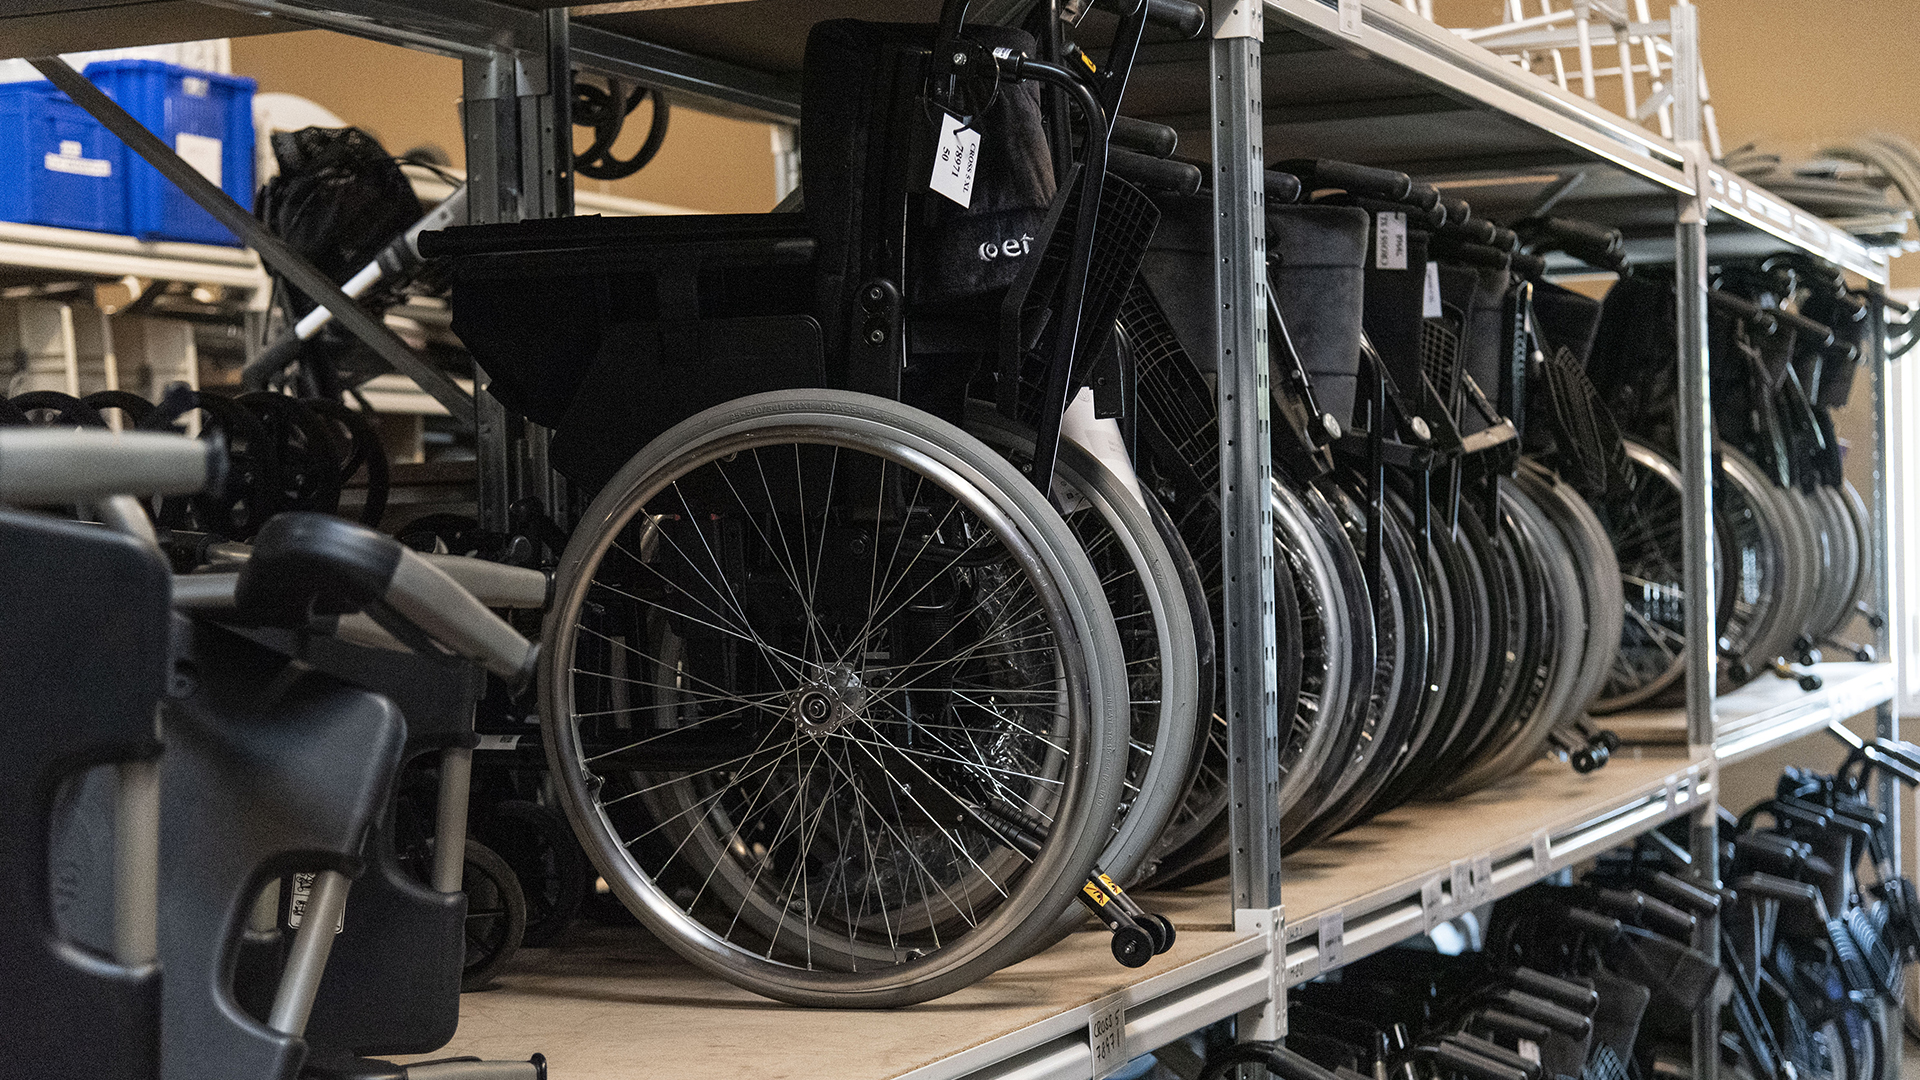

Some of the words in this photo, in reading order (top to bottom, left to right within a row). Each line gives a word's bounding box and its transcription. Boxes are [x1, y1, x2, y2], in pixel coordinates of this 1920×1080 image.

[941, 146, 951, 162] 50
[951, 145, 964, 178] 78971
[966, 143, 976, 173] CROSS
[963, 181, 970, 193] XL
[1094, 1014, 1112, 1038] CROSS
[1115, 1008, 1120, 1026] 5
[1096, 1028, 1120, 1062] 78971
